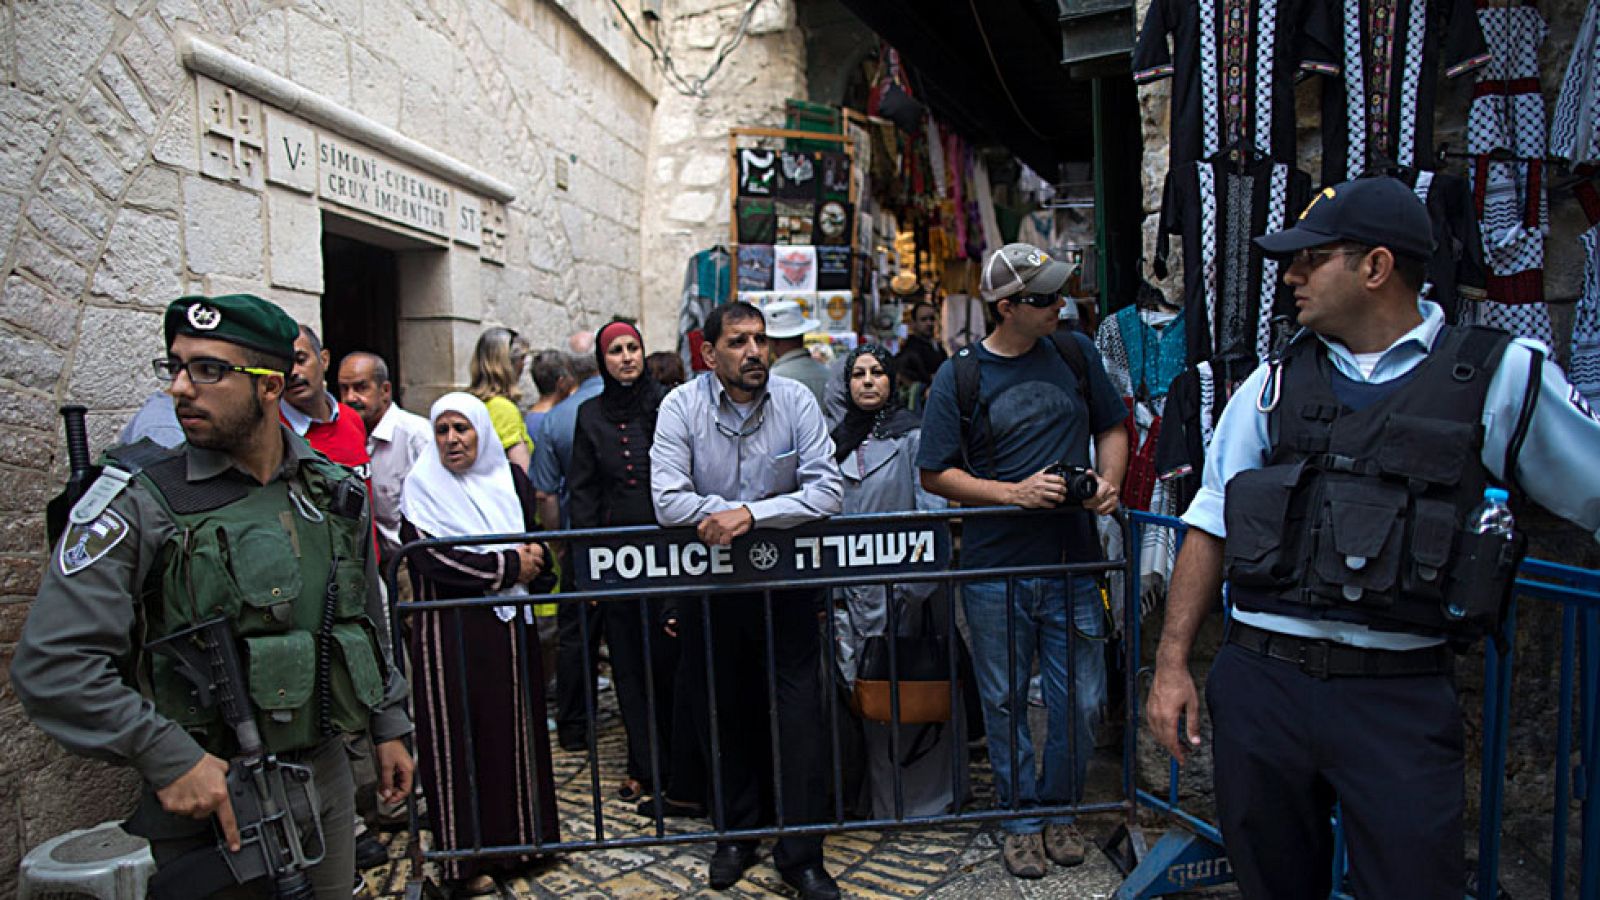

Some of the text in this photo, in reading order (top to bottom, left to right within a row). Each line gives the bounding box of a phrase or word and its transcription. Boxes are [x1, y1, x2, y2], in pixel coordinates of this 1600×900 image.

[328, 173, 368, 203] CRUX
[588, 542, 734, 580] POLICE
[795, 530, 935, 570] משטרה
